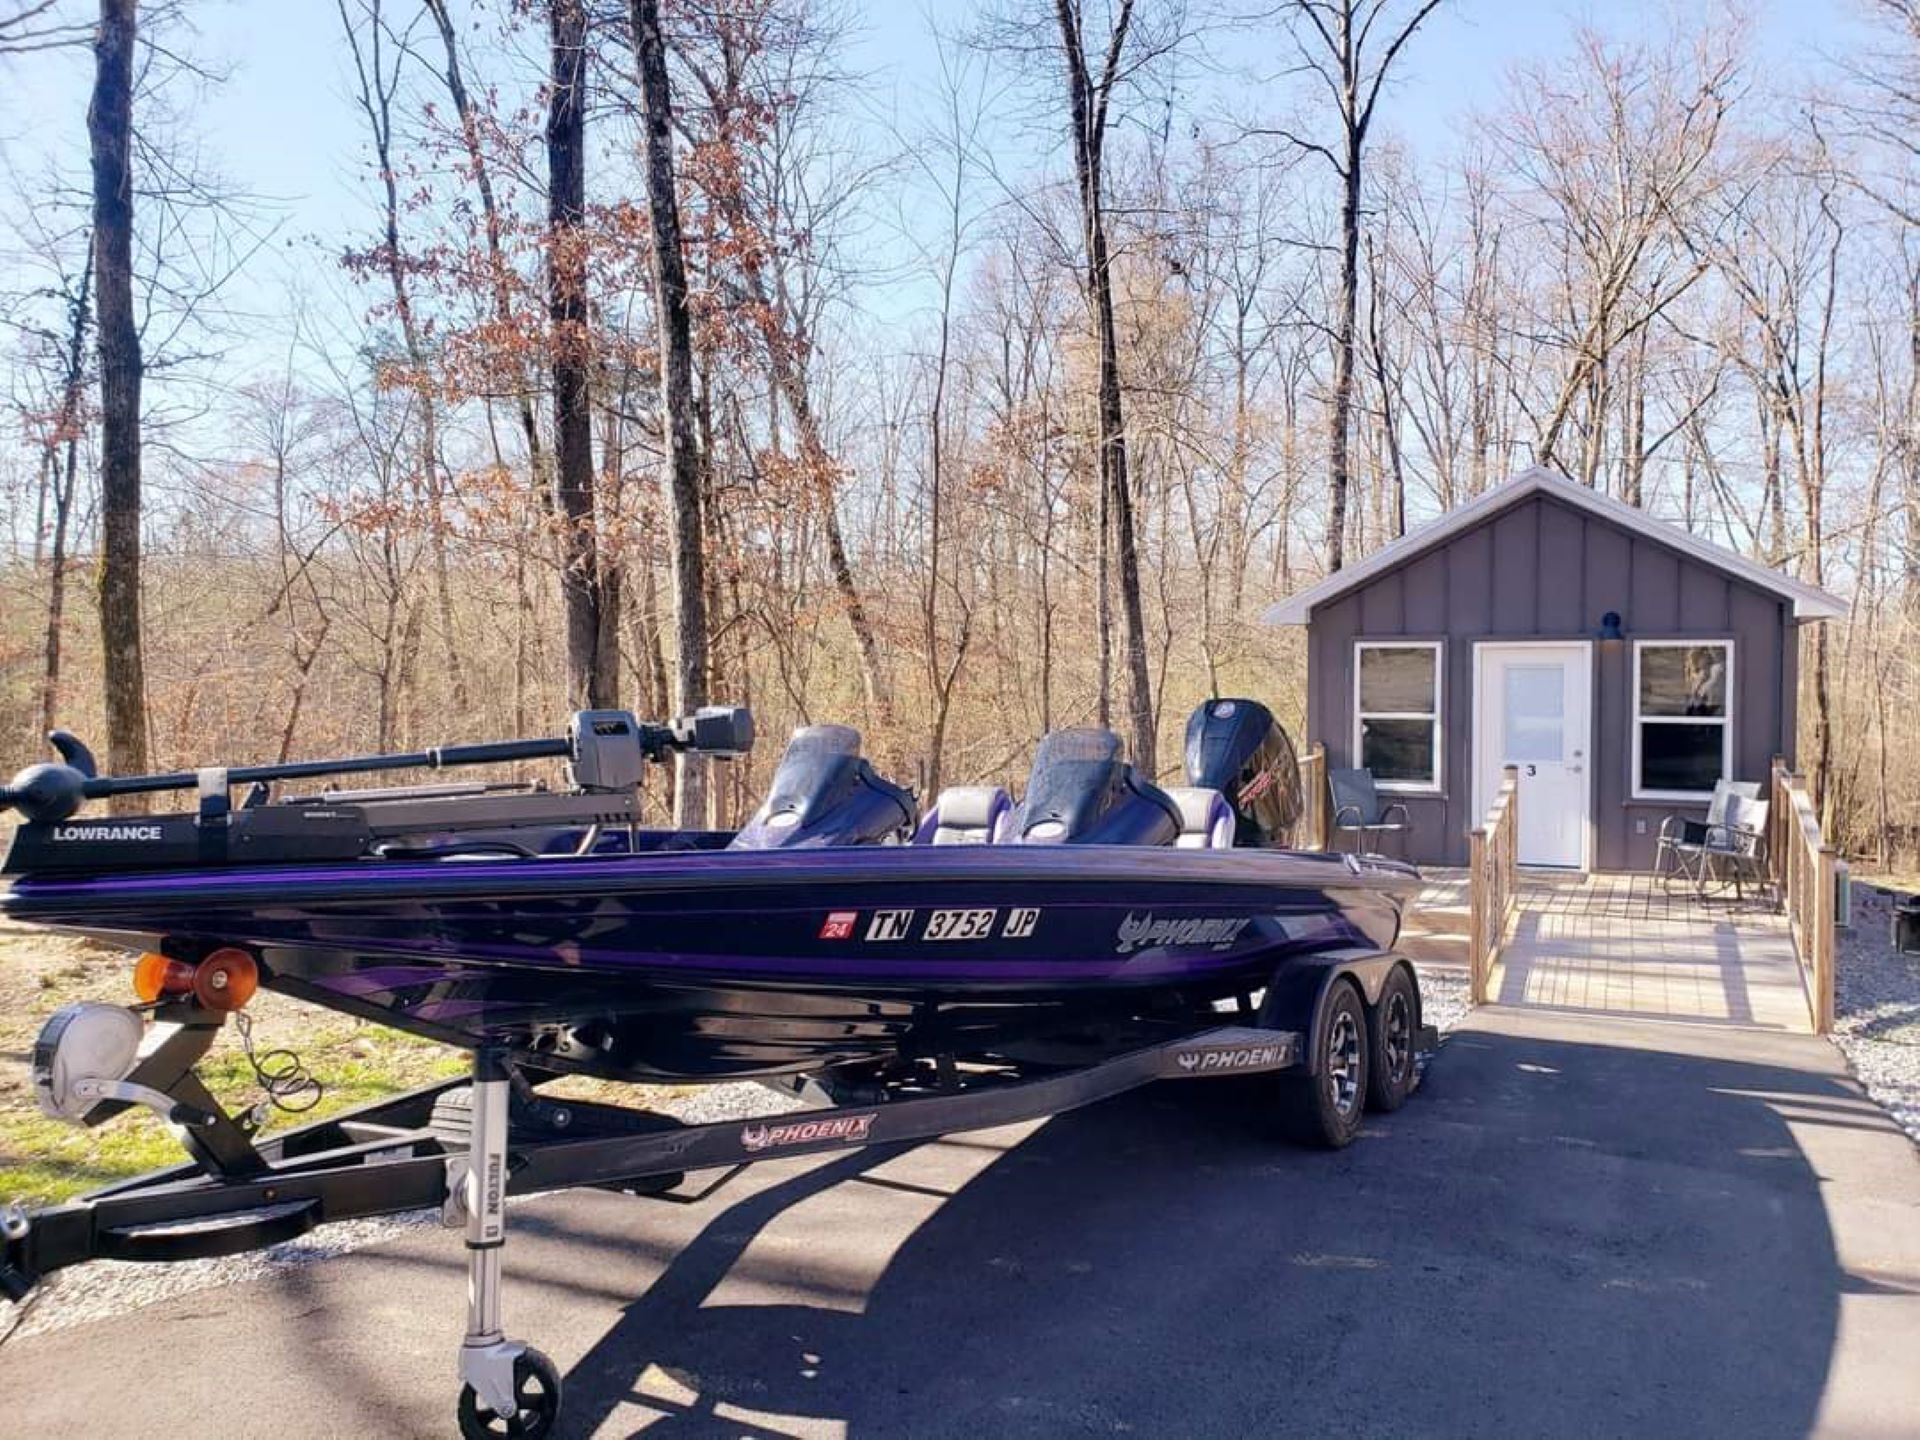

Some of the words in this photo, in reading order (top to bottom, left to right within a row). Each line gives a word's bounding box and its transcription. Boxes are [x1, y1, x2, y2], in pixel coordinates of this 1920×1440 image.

[1527, 764, 1536, 777] 3
[54, 826, 162, 841] LOWRANCE
[826, 924, 848, 937] 24
[873, 912, 911, 939] TN
[928, 911, 993, 938] 3752
[1007, 910, 1037, 935] JP
[768, 1113, 877, 1146] PHOENIX
[488, 1153, 501, 1215] FULTON
